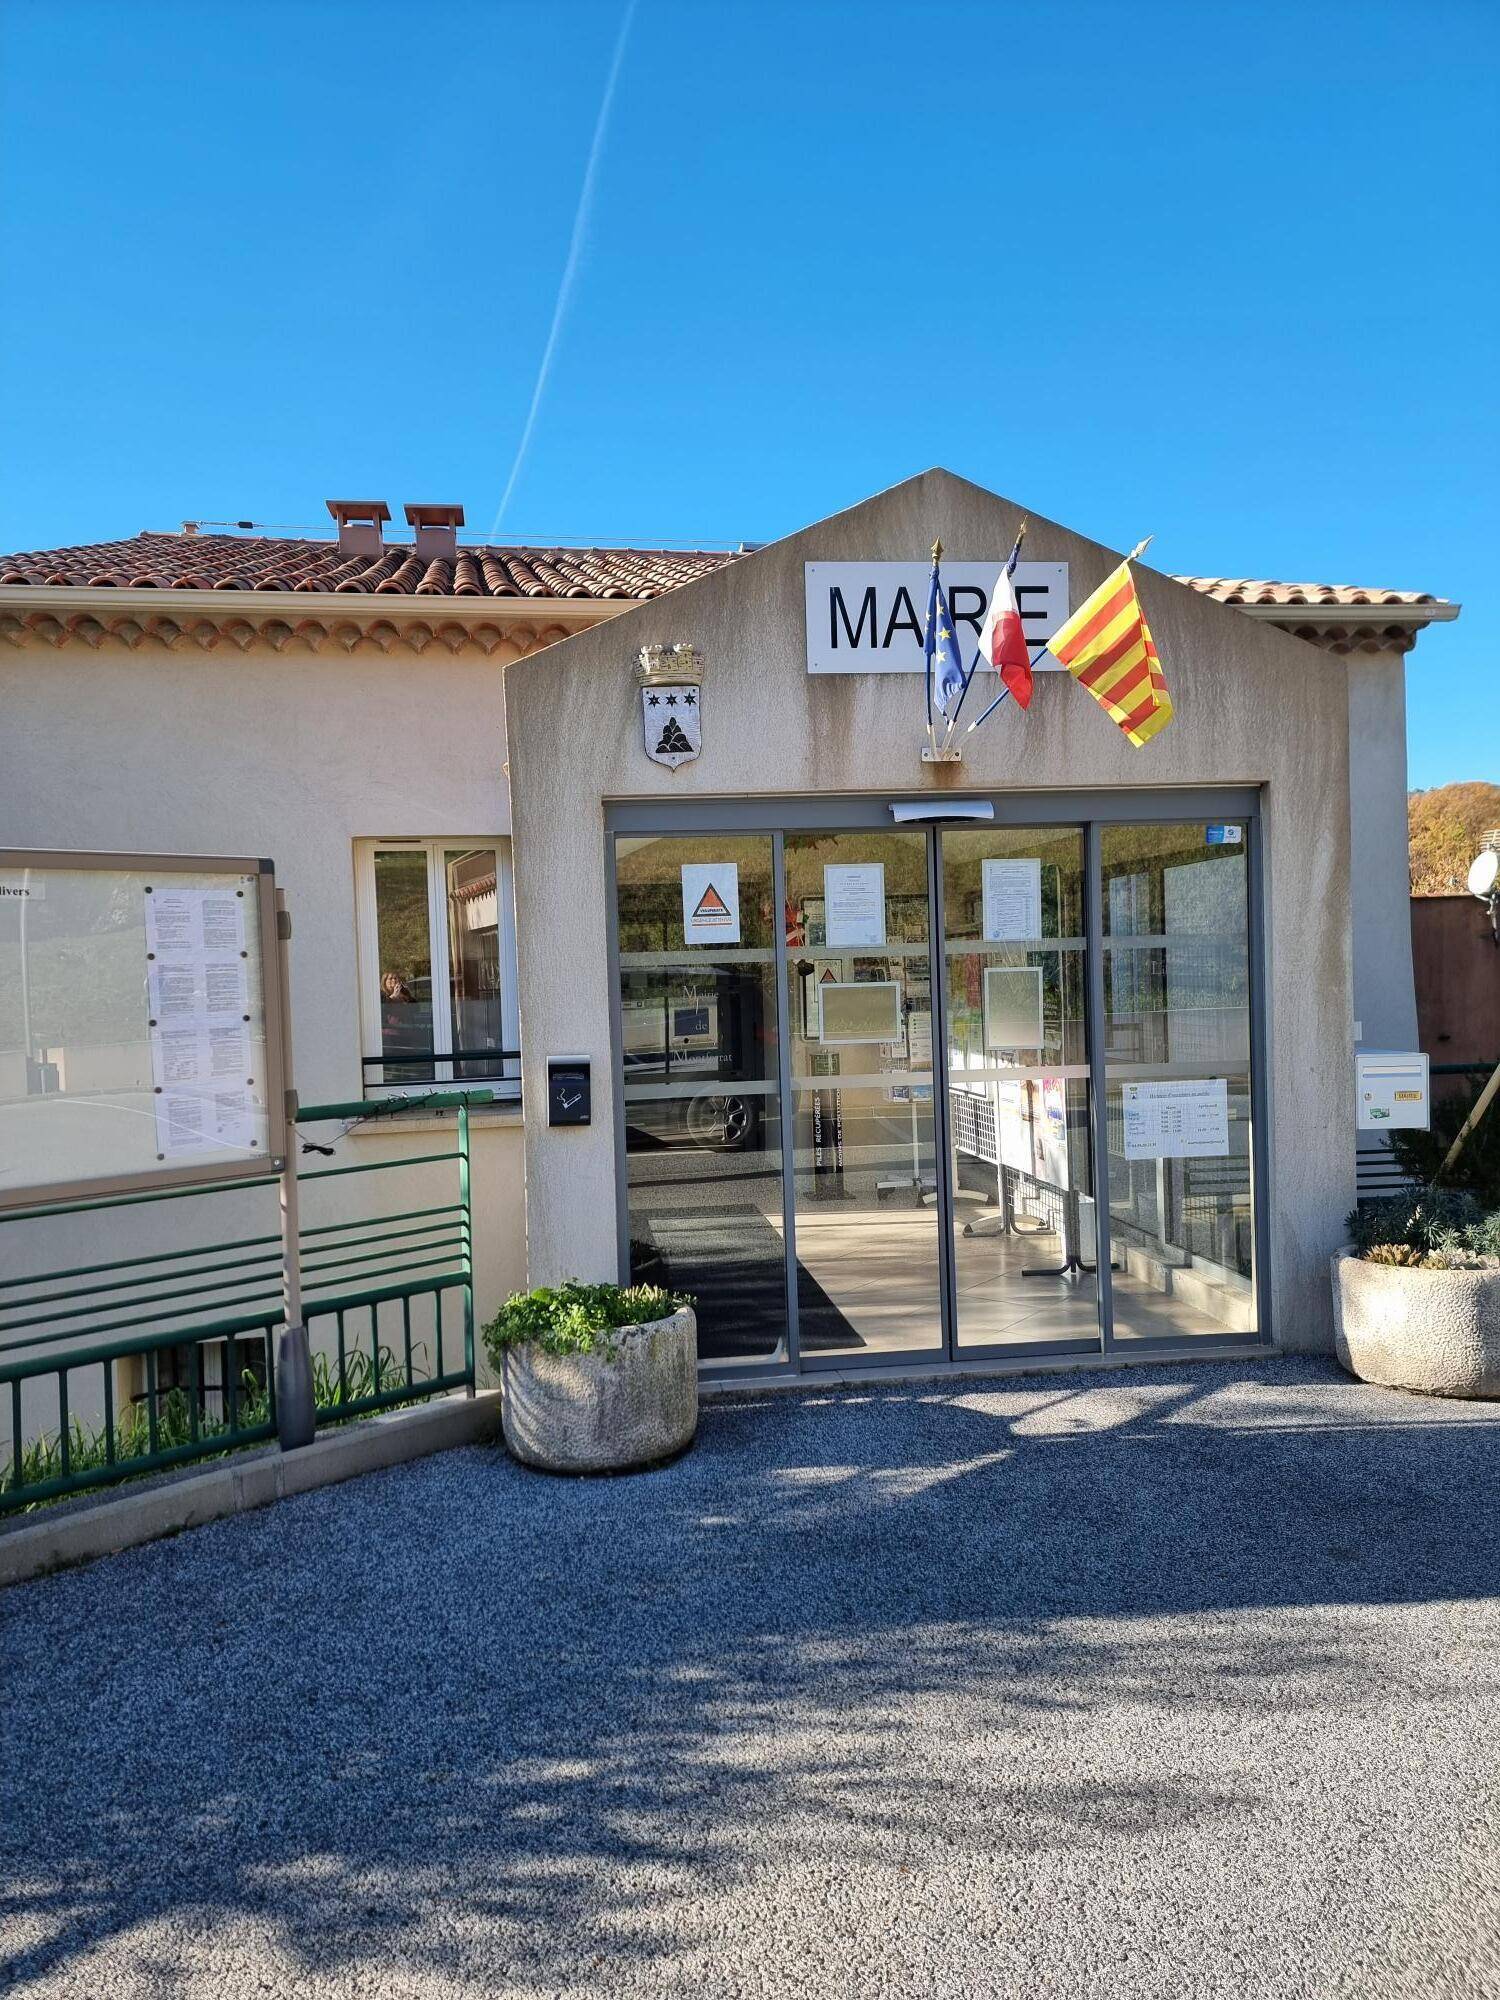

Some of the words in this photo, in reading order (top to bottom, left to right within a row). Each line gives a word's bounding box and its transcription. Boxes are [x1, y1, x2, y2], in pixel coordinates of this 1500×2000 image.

[829, 586, 1049, 649] MARE
[0, 885, 30, 896] ivers
[695, 1020, 708, 1031] de
